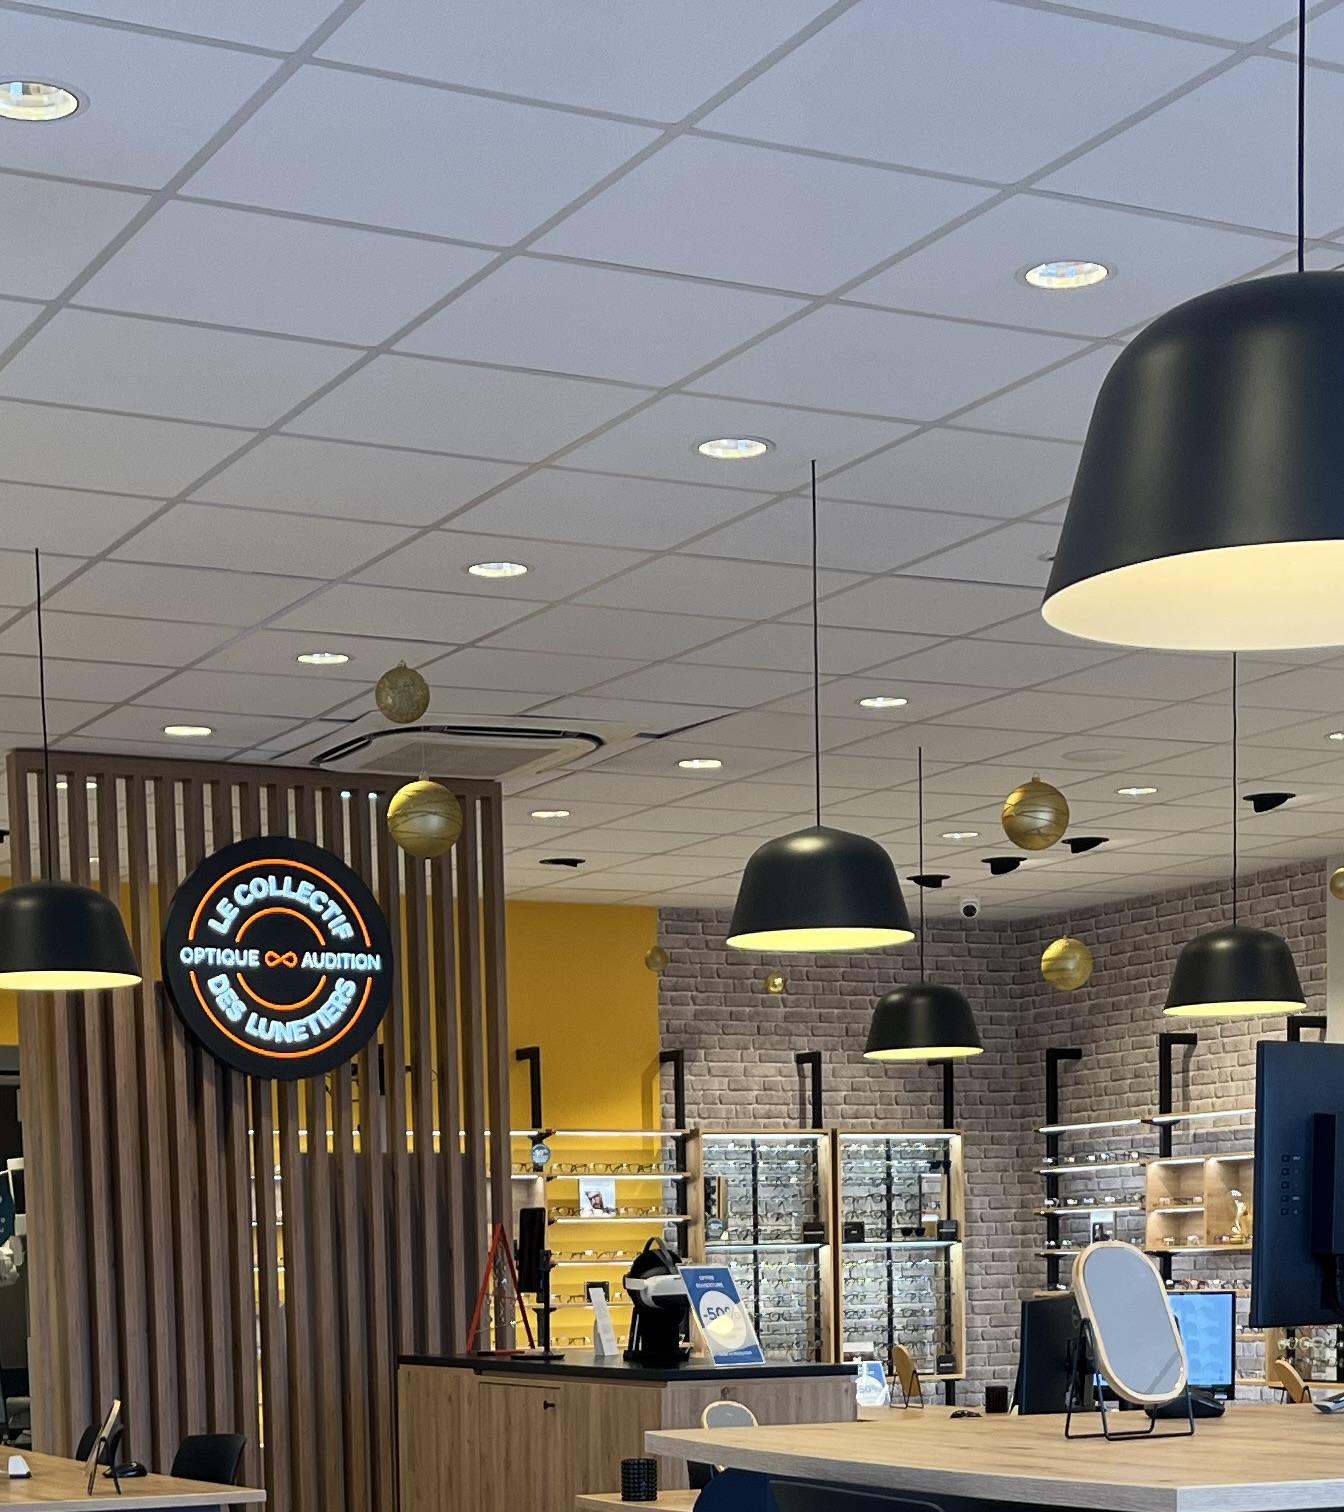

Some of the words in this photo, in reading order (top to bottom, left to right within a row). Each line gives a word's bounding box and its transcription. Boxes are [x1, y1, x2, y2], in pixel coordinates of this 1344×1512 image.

[207, 897, 240, 935] LE
[233, 875, 356, 941] COLLECTIF
[179, 946, 261, 968] OPTIQUE
[300, 950, 382, 971] AUDITION
[207, 973, 248, 1023] DES
[244, 977, 357, 1044] LUNETIERS
